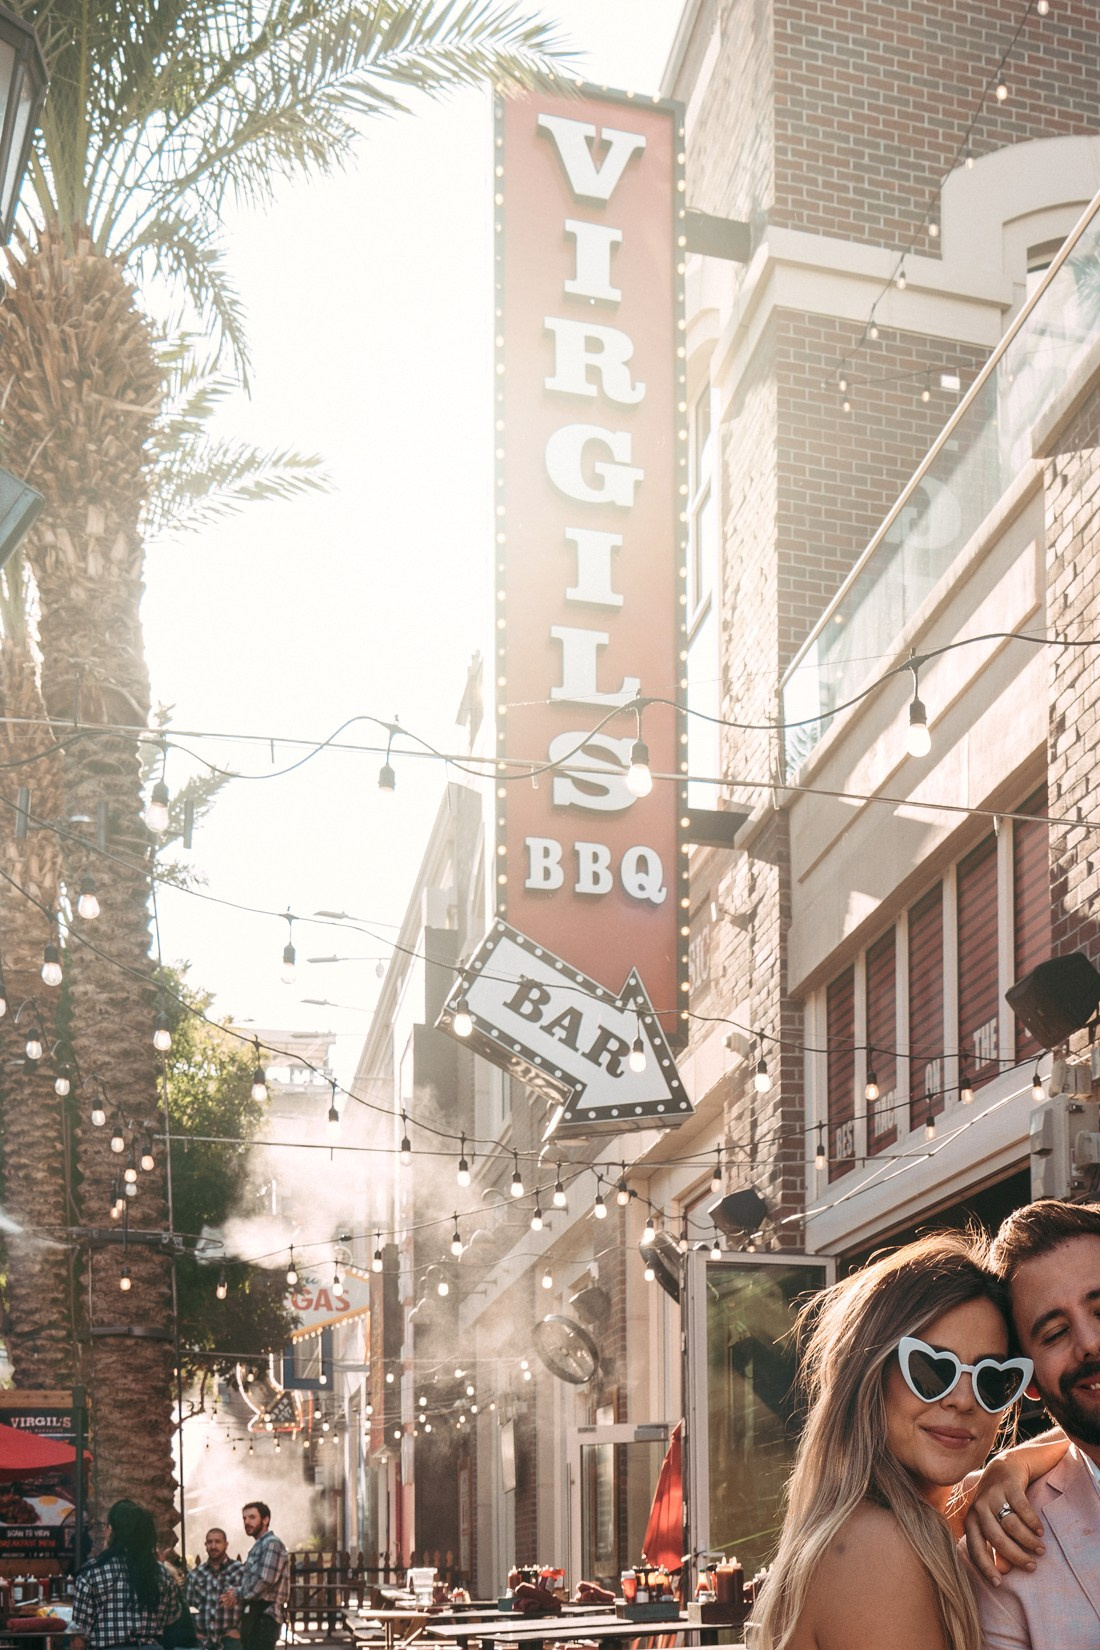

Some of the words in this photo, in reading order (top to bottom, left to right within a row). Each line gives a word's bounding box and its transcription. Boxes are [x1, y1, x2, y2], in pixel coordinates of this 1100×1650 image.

[537, 113, 646, 811] VIRGILS
[525, 836, 667, 904] BBQ
[503, 973, 632, 1079] BAR
[973, 1017, 997, 1071] THE
[836, 1120, 854, 1160] BES
[284, 1283, 350, 1312] GAS
[10, 1416, 72, 1429] VIRGIL'S
